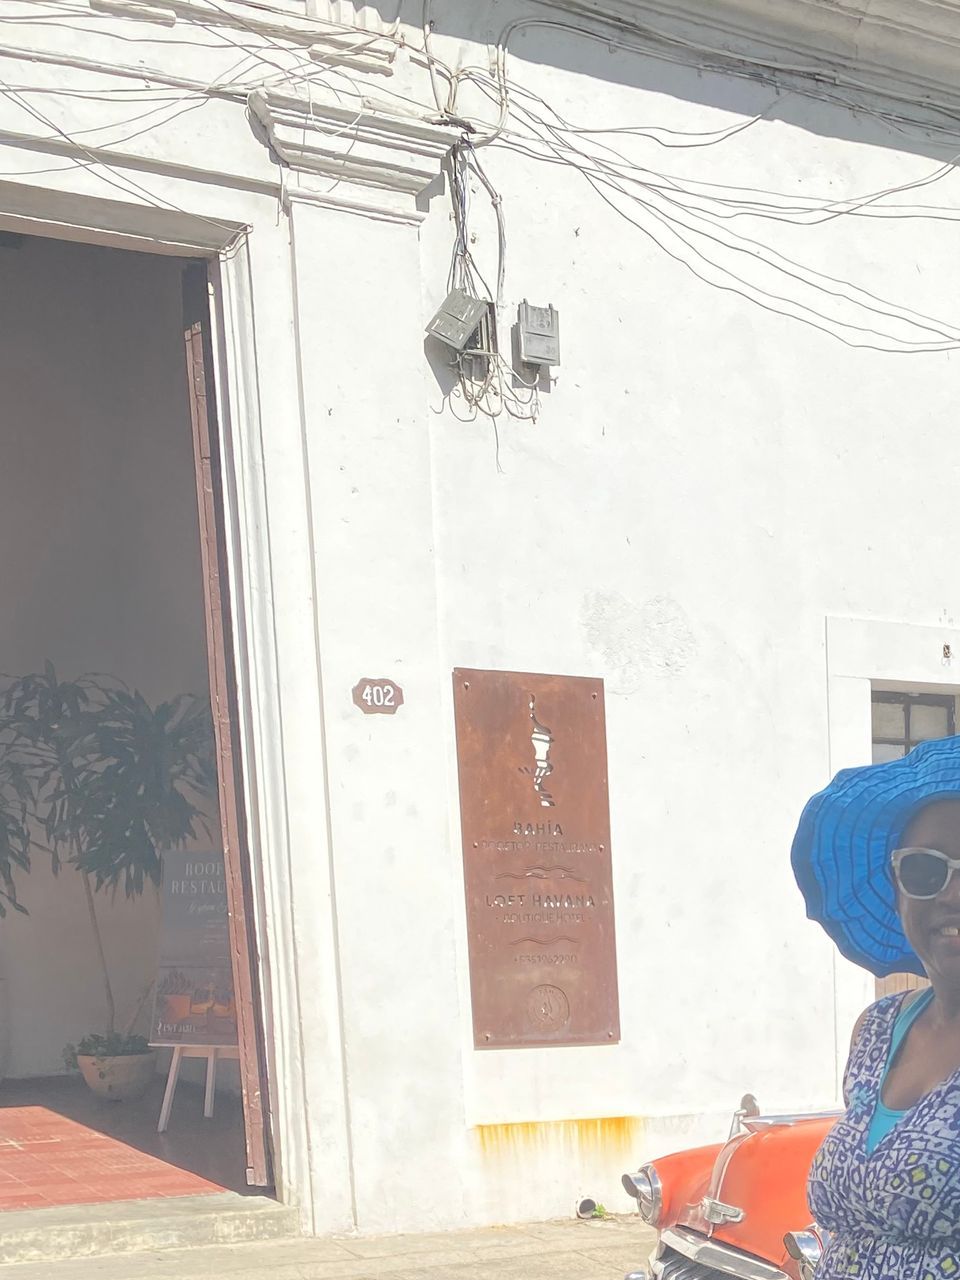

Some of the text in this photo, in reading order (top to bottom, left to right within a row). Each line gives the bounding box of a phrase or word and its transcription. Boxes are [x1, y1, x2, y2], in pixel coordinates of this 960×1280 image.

[362, 685, 395, 706] 402
[486, 894, 596, 910] LOFT HAVANA
